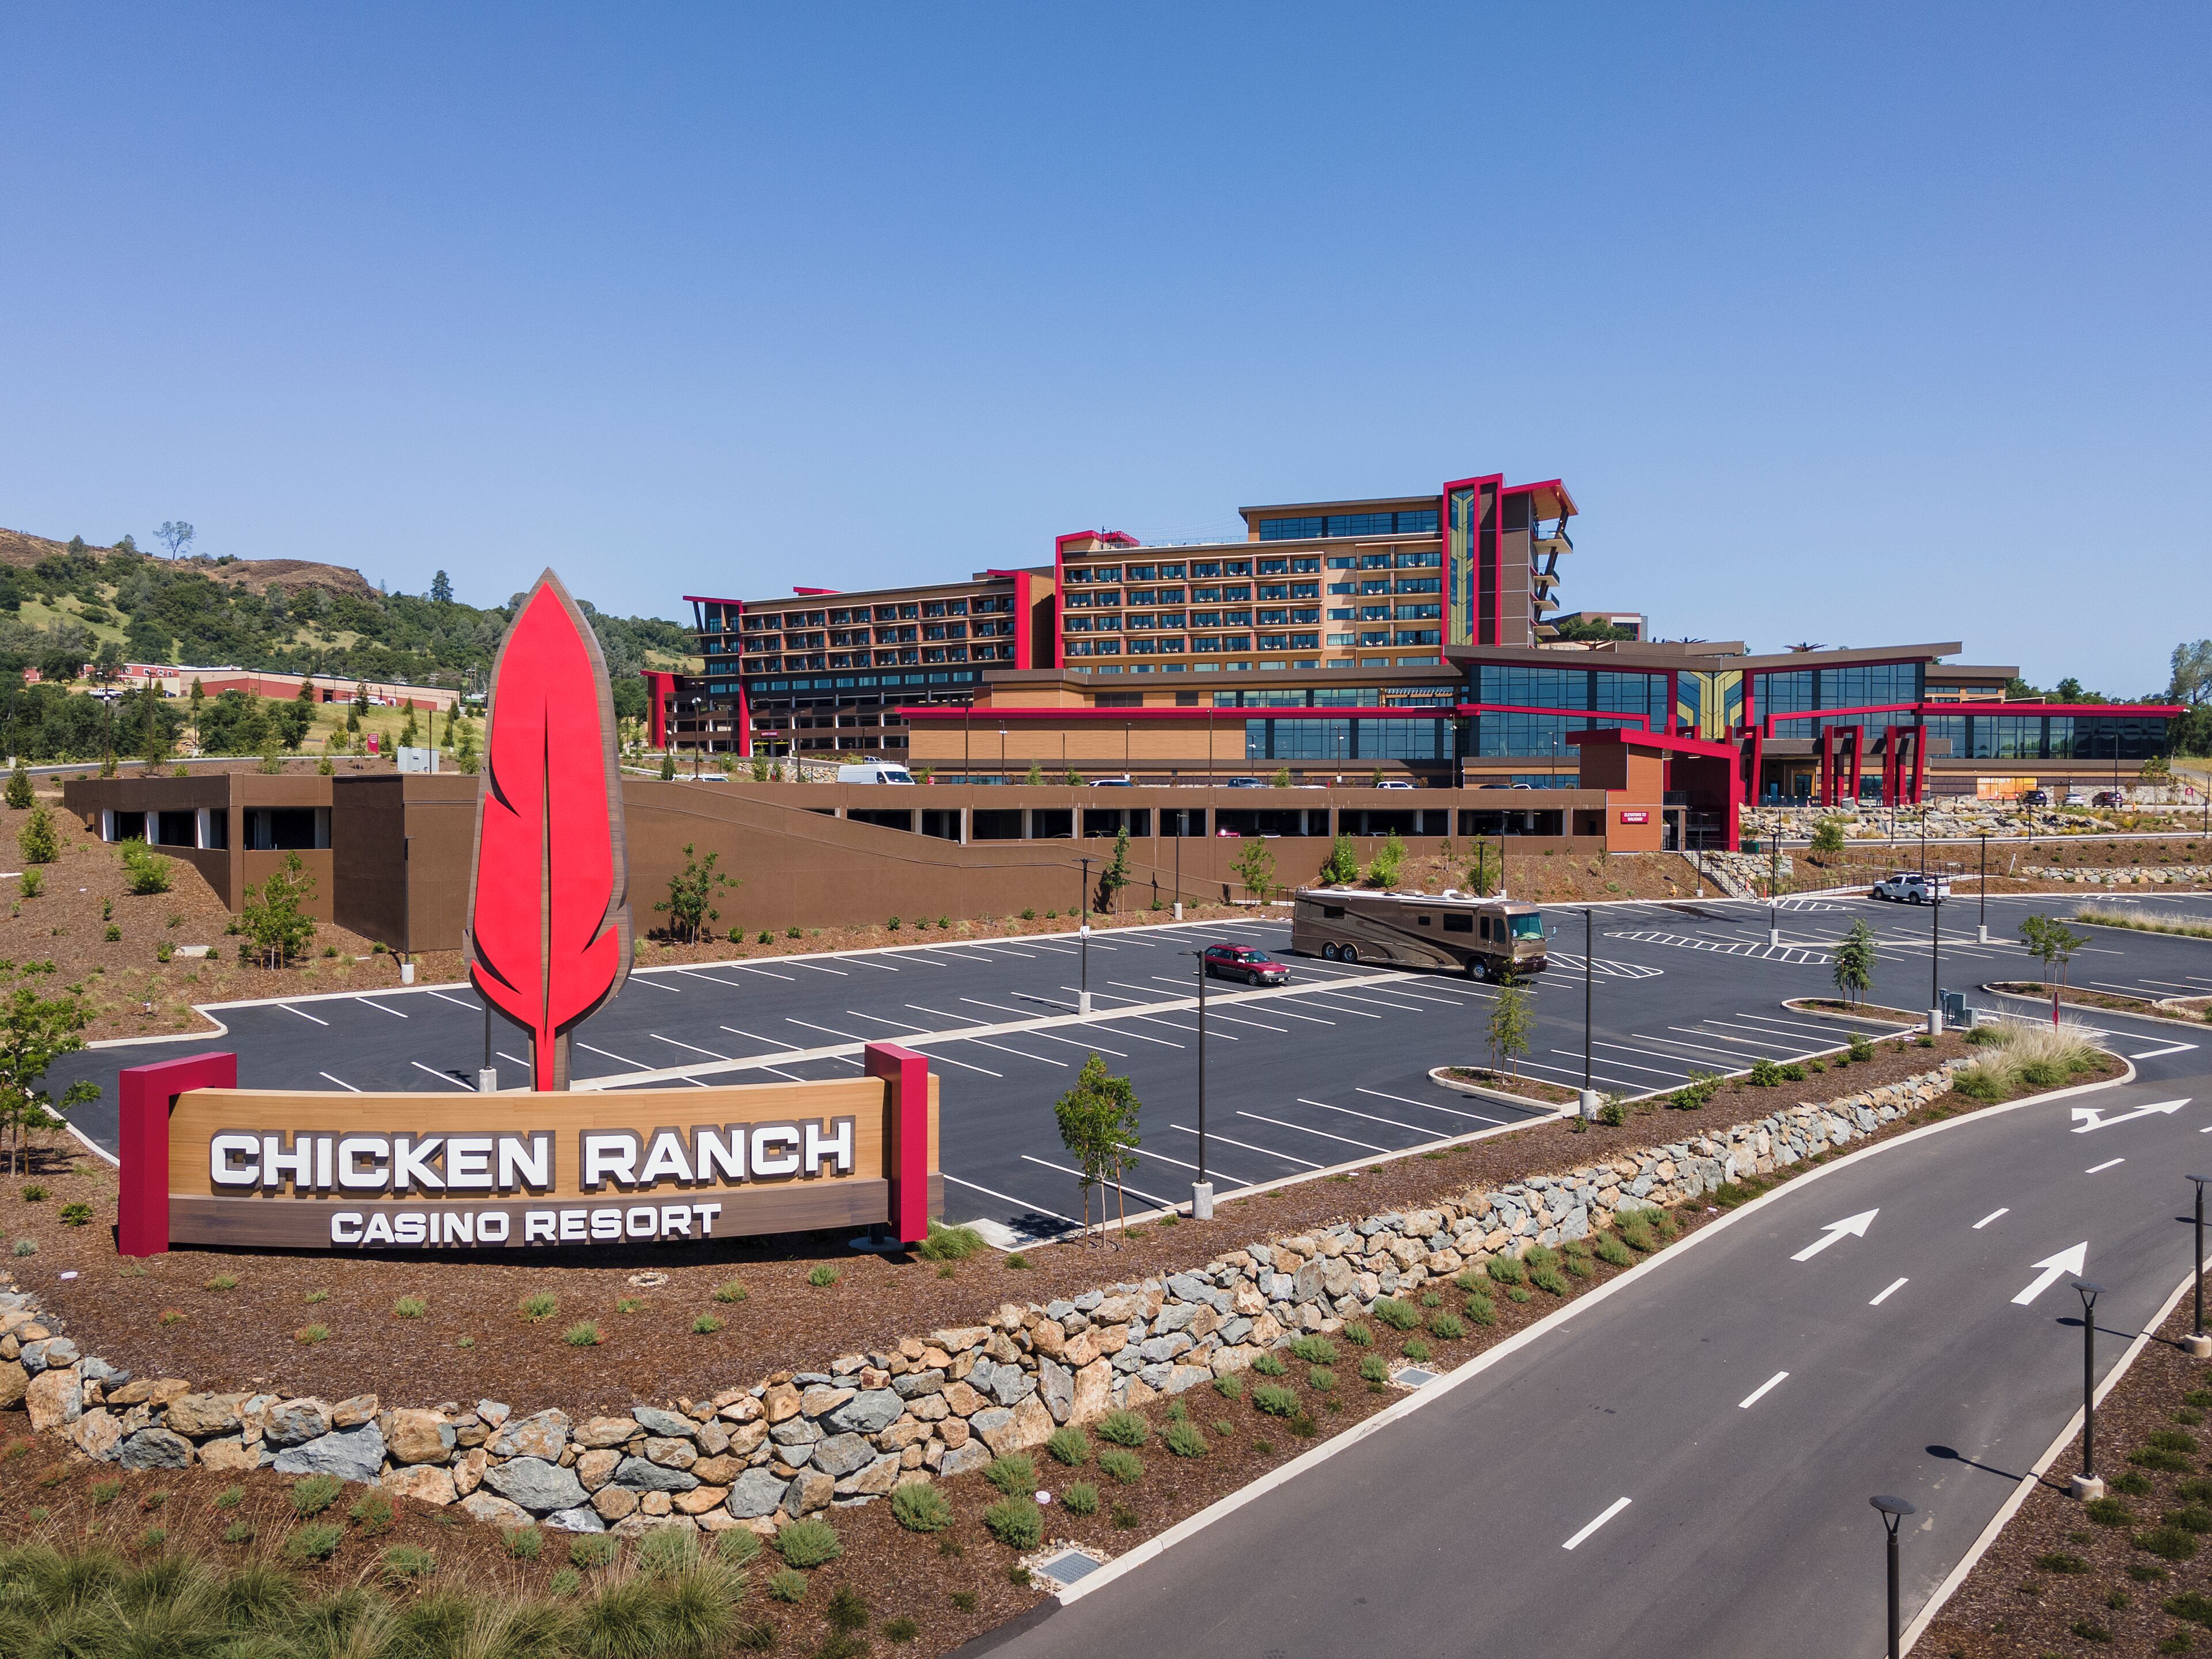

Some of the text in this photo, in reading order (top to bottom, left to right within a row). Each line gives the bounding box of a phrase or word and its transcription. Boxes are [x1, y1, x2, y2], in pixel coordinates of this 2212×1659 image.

[211, 1122, 852, 1188] CHICKEN RANCH
[331, 1203, 722, 1244] CASINO RESORT
